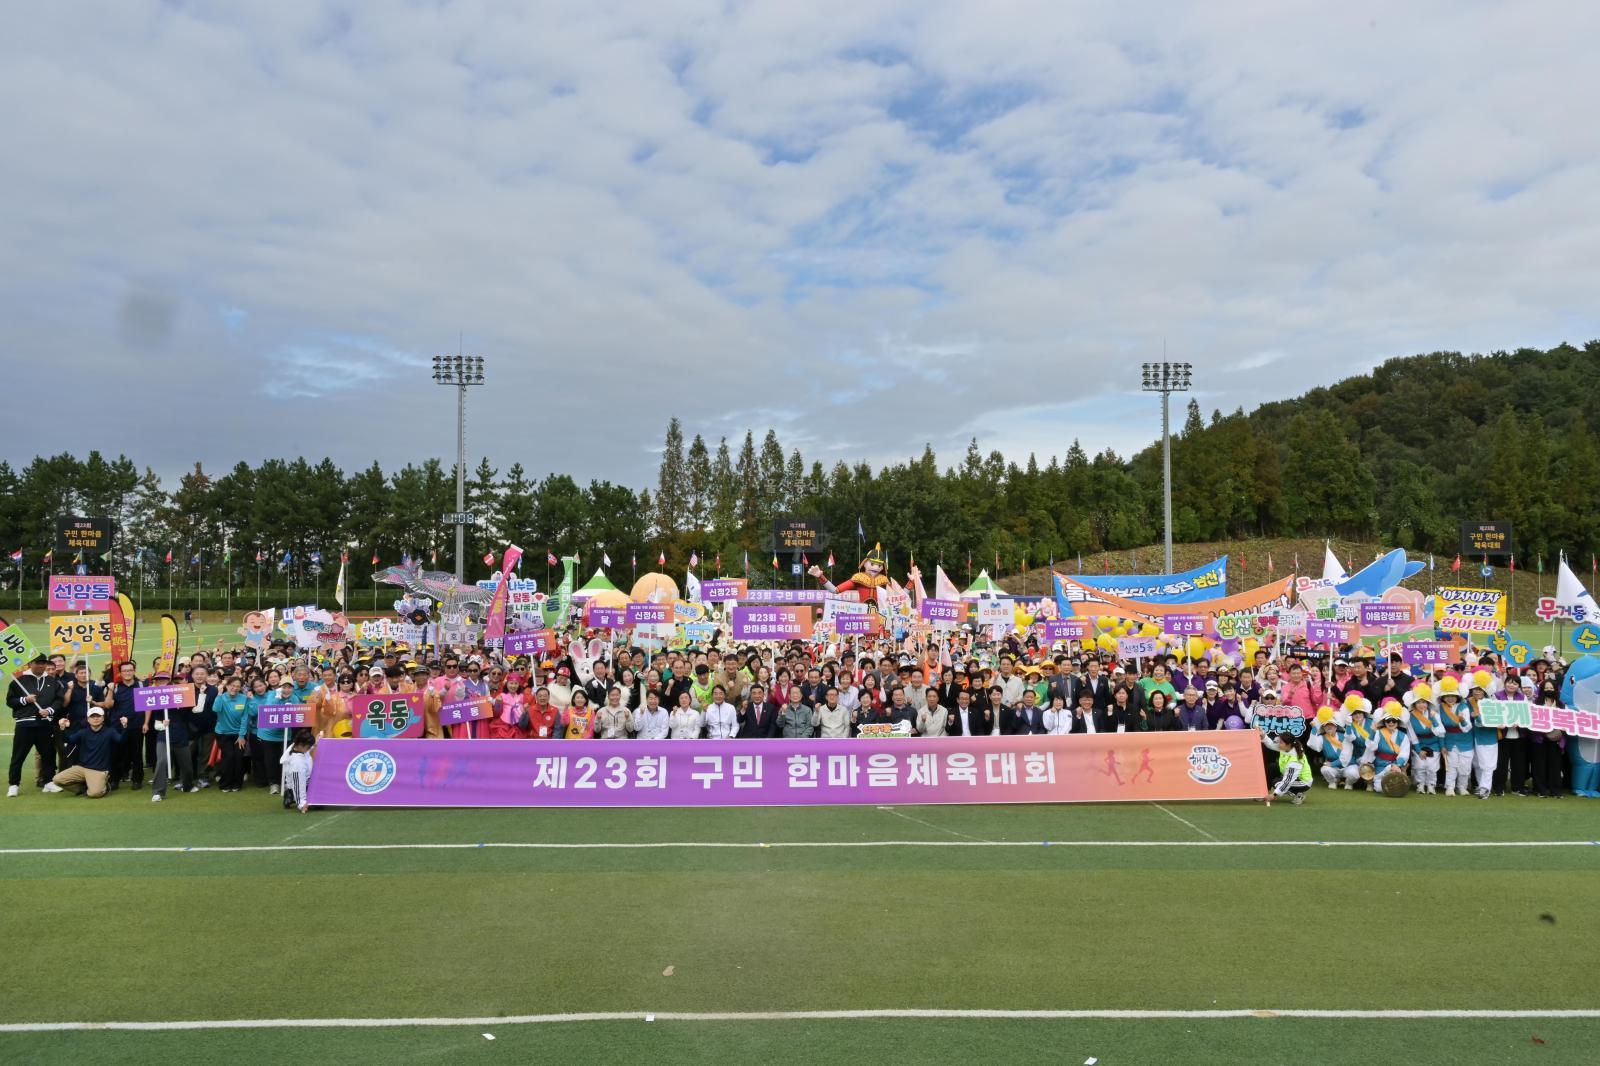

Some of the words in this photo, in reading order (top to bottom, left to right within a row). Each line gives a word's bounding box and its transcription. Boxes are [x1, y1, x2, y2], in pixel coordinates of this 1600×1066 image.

[64, 530, 78, 538] 구민
[80, 530, 102, 538] 한마음
[780, 530, 793, 538] 구민
[795, 530, 816, 538] 한마음
[1469, 532, 1483, 541] 구민
[77, 565, 86, 574] A
[793, 565, 801, 574] B
[54, 583, 110, 600] 선암동
[709, 586, 739, 597] 신정2동
[776, 591, 793, 600] 구민
[1442, 590, 1501, 602] 아자아자
[635, 611, 665, 620] 신정4동
[930, 607, 959, 618] 신정3동
[1444, 603, 1496, 617] 수암동
[1537, 599, 1587, 621] 무거동
[748, 613, 776, 622] 제23회
[780, 613, 796, 622] 구민
[743, 624, 801, 634] 한마음체육대회
[844, 621, 870, 631] 신정1동
[1173, 621, 1204, 631] 삼산동
[1441, 618, 1498, 631] 화이팅!!
[54, 622, 111, 644] 선암동
[1054, 626, 1083, 637] 신정5동
[1316, 629, 1349, 640] 무거동
[1577, 628, 1599, 649] 수
[514, 638, 546, 651] 삼호동
[1413, 650, 1449, 660] 수암동
[146, 694, 183, 706] 선암동
[269, 713, 305, 724] 대현동
[366, 698, 410, 731] 옥동
[1481, 702, 1531, 726] 함께
[1531, 705, 1600, 736] 행복한
[532, 756, 668, 790] 제23회
[691, 756, 765, 790] 구민
[787, 751, 1057, 788] 한마음체육대회
